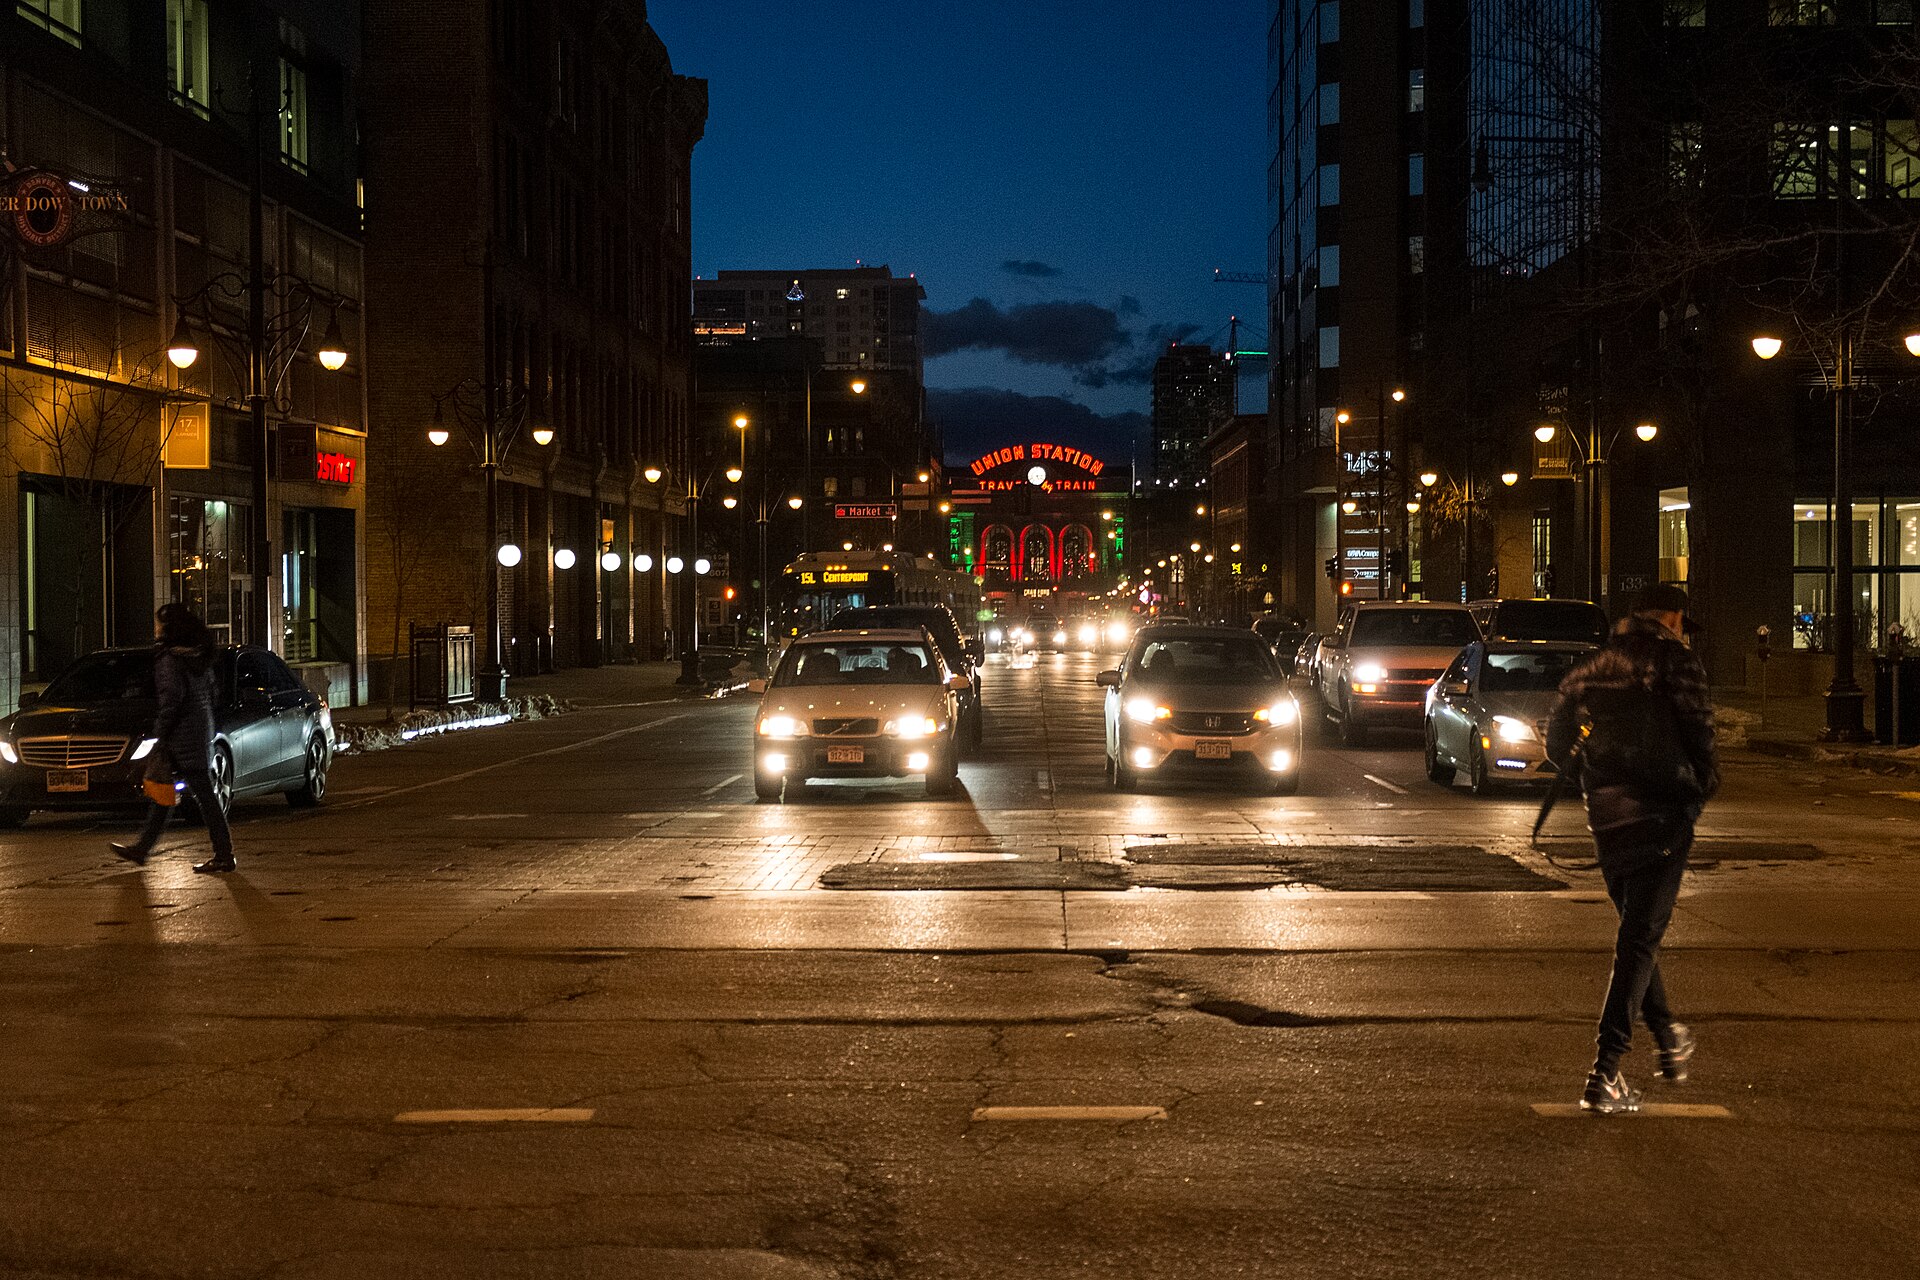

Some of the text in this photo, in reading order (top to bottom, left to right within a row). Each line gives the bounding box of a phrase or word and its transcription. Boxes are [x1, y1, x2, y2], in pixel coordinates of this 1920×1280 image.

[970, 443, 1105, 476] UNION STATION
[1040, 480, 1054, 494] by
[1056, 480, 1096, 490] TRAIN
[849, 506, 881, 516] Market
[800, 572, 816, 584] 15L
